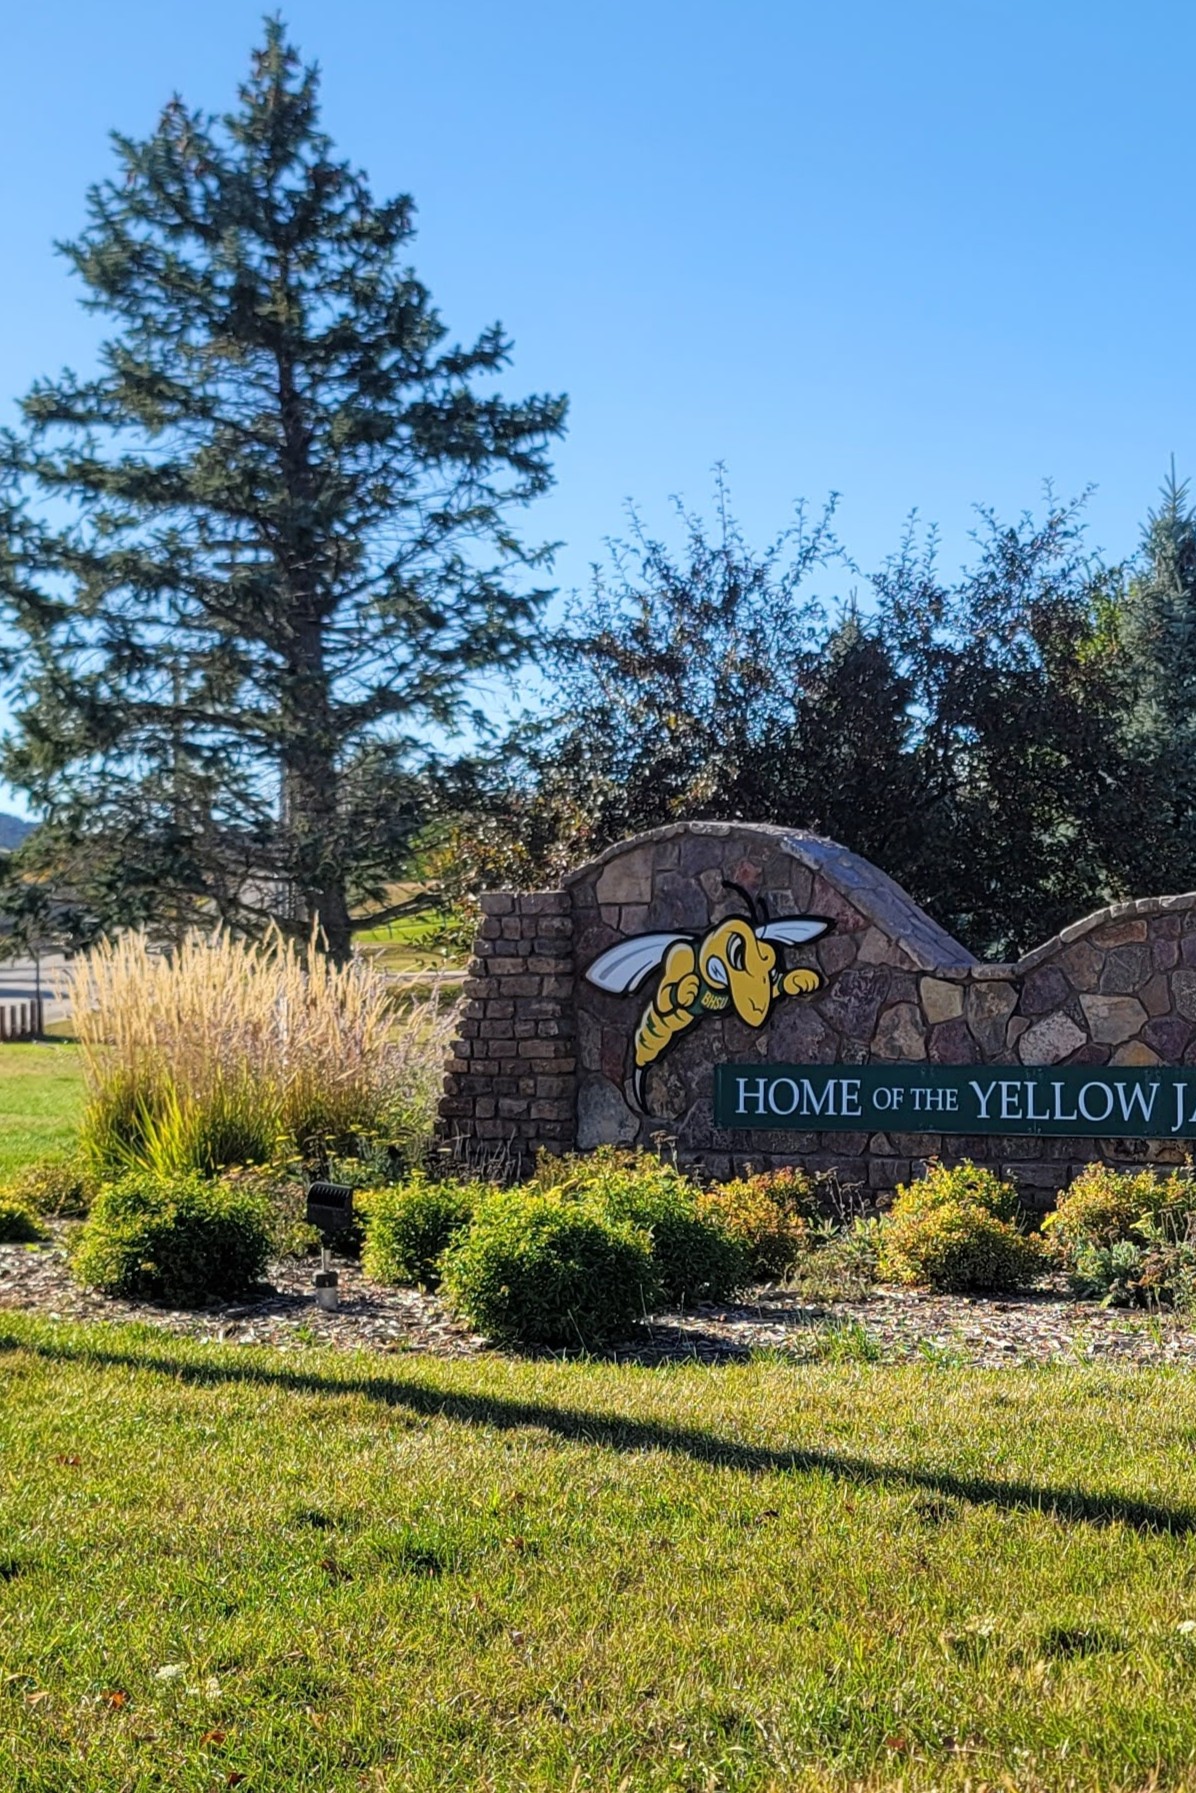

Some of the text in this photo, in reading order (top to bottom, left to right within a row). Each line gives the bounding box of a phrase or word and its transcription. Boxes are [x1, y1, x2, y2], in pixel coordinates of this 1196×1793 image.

[701, 990, 729, 1010] BHSU
[734, 1077, 863, 1116] HOME
[871, 1087, 904, 1111] OF
[909, 1087, 960, 1112] THE
[967, 1079, 1161, 1123] YELLOW
